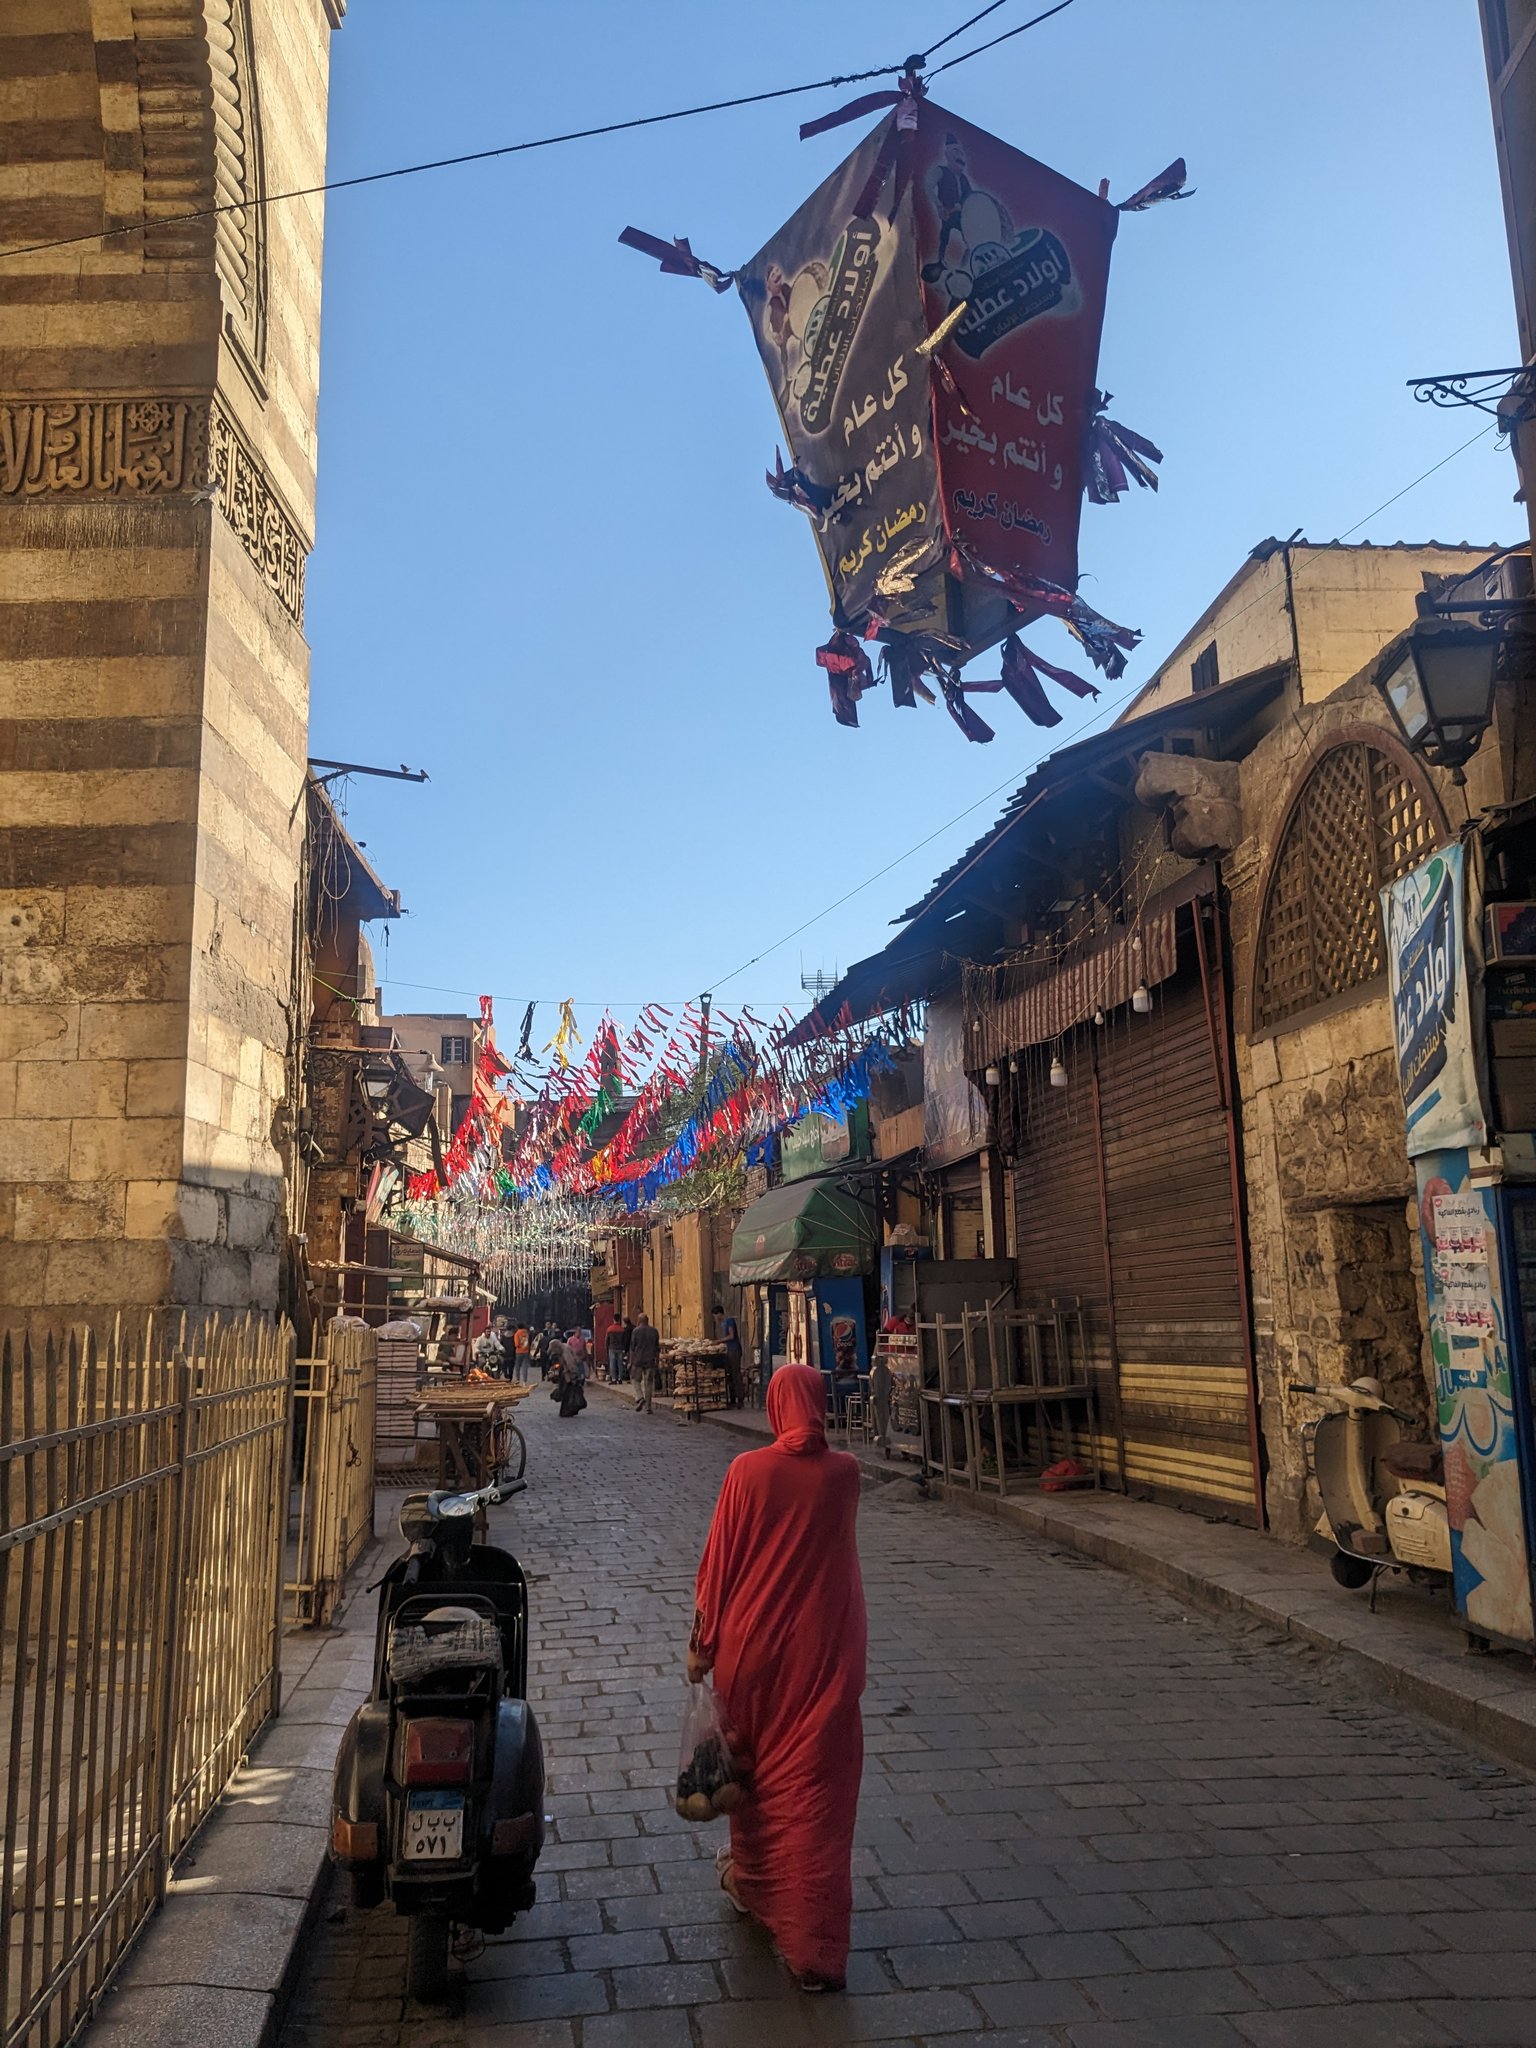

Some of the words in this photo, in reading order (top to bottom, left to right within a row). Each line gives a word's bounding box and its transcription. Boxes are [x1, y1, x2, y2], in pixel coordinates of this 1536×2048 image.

[843, 230, 873, 320] أولاد
[1012, 243, 1063, 297] أولاد
[803, 329, 844, 423] عطية
[882, 354, 908, 411] كل
[991, 371, 1031, 409] عام
[843, 393, 877, 447] عام
[1036, 391, 1065, 426] كل
[865, 422, 907, 495] أنتم
[911, 423, 923, 460] و
[940, 416, 998, 466] بخير
[1002, 435, 1047, 475] أنتم
[818, 471, 862, 533] بخير
[1049, 462, 1063, 491] و
[876, 501, 927, 553] رمضان
[952, 488, 998, 521] كريم
[999, 502, 1053, 547] رمضان
[839, 528, 873, 583] كريم
[1415, 900, 1452, 1028] أولاد
[1466, 1206, 1481, 1217] زبادي
[415, 1836, 446, 1855] ٥٧١
